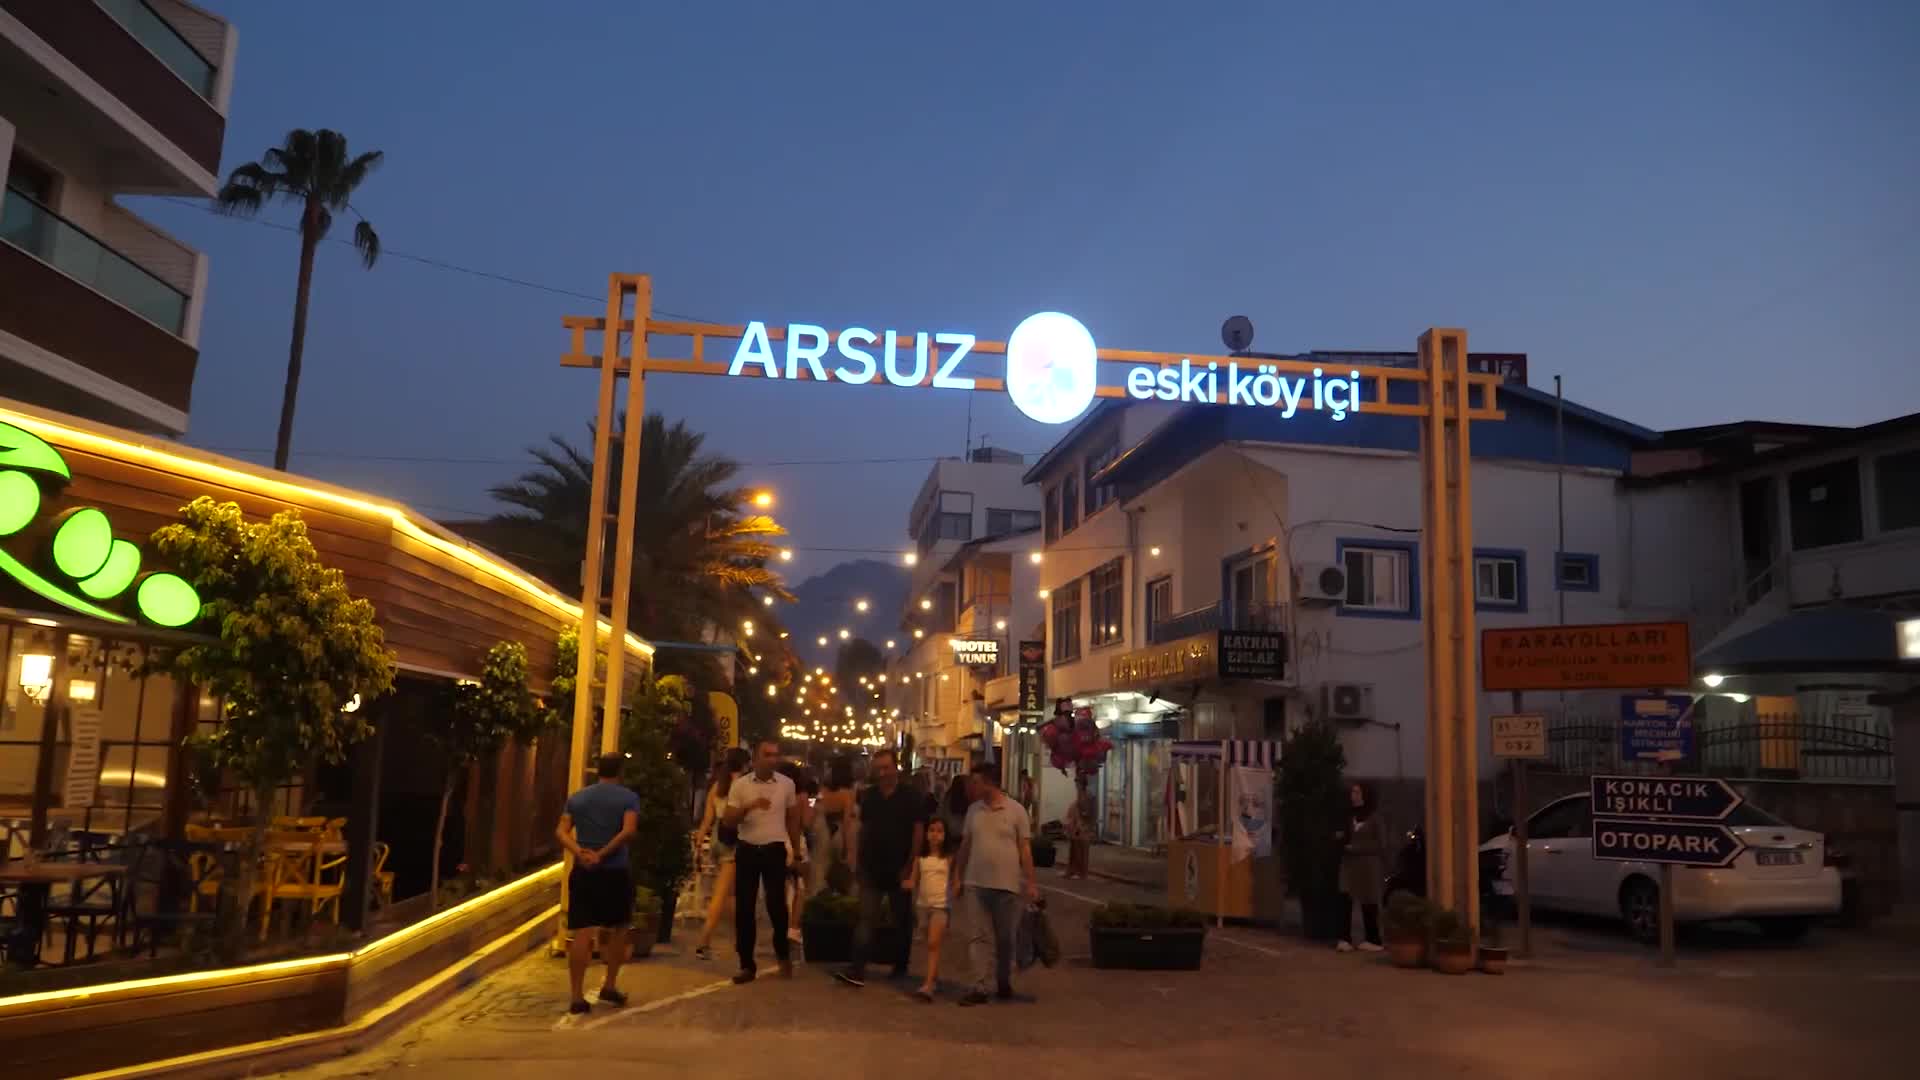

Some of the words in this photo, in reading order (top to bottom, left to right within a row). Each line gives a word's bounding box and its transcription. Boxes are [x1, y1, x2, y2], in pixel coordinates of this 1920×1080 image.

[728, 320, 976, 389] ARSUZ
[1127, 358, 1218, 403] eski
[1229, 362, 1306, 419] köy
[1313, 367, 1360, 421] içi
[956, 640, 998, 652] HOTEL
[1500, 630, 1668, 650] KARAYOLLARI
[959, 653, 997, 664] YUNUS
[1605, 781, 1709, 798] KONACIK
[1606, 797, 1673, 814] IŞIKLI
[1600, 831, 1720, 855] OTOPARK
